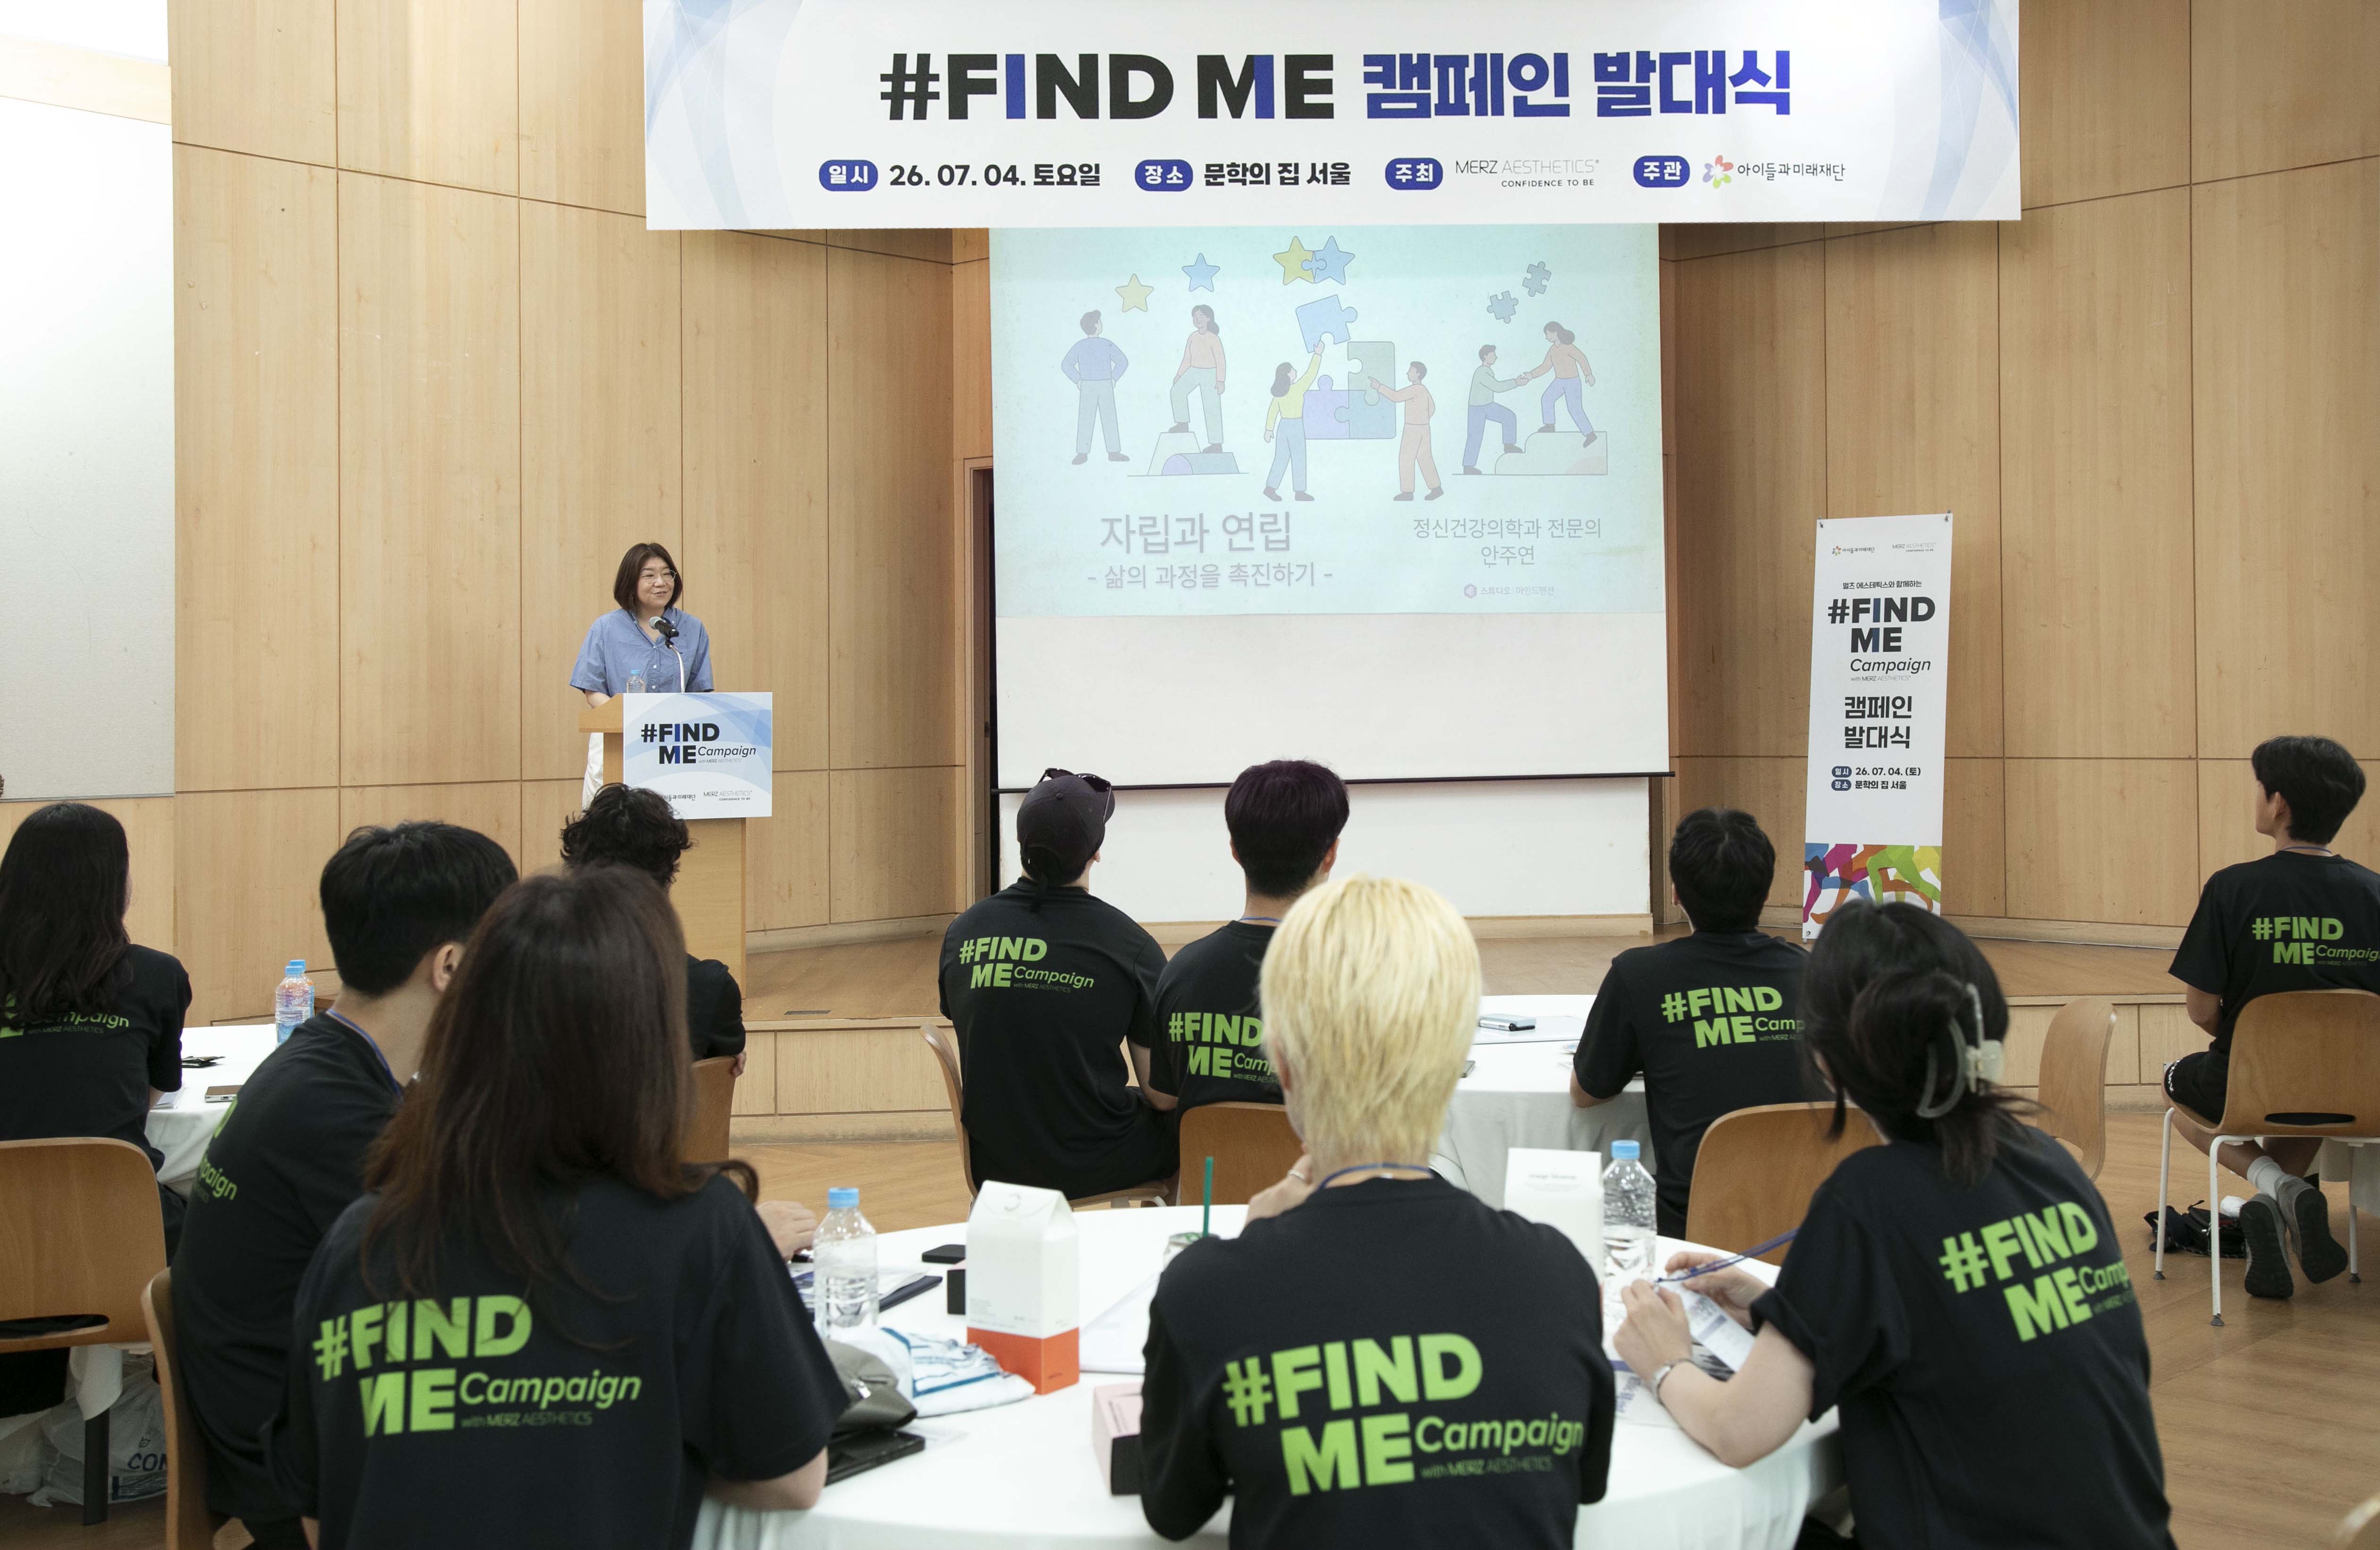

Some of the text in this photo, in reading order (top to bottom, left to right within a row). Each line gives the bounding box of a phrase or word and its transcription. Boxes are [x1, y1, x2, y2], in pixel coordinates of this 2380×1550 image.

[880, 51, 1790, 120] #FIND ME 캠페인 발대식
[829, 163, 1100, 186] 일시 26. 07. 04. 토요일
[1145, 162, 1351, 186] 장소 문학의 집 서울
[1396, 163, 1433, 182] 주최
[1456, 161, 1497, 173] MERZ
[1644, 162, 1681, 180] 주관
[1738, 163, 1845, 181] 아이들과미래재단
[1100, 511, 1290, 554] 자립과 연립
[1414, 518, 1600, 538] 정신건강의학과 전문의
[1481, 545, 1534, 566] 안주연
[1105, 565, 1146, 589] 삶의
[1156, 564, 1220, 589] 과정을
[1229, 562, 1314, 587] 촉진하기
[1856, 581, 1895, 589] 에스테틱스와
[1828, 597, 1935, 623] #FIND
[1851, 627, 1902, 653] ME
[1851, 658, 1930, 674] Campaign
[1845, 696, 1912, 718] 캠페인
[641, 723, 720, 742] #FIND
[1844, 726, 1910, 749] 발대식
[659, 745, 756, 764] ME Campaign
[1856, 767, 1870, 775] 26.
[1872, 767, 1886, 775] 07.
[1888, 767, 1903, 775] 04.
[1905, 767, 1921, 776] (토)
[1855, 780, 1878, 789] 문학의
[1881, 781, 1888, 789] 집
[1891, 781, 1906, 789] 서울
[2252, 917, 2344, 940] #FIND
[960, 937, 1047, 964] #FIND
[2273, 942, 2380, 964] ME Campaig
[970, 963, 1094, 989] ME Campaign
[1661, 987, 1783, 1023] #FIND
[1169, 1012, 1264, 1047] #FIND
[1694, 1016, 1756, 1048] ME
[1188, 1045, 1233, 1078] ME
[1939, 1201, 2098, 1293] #FIND
[2003, 1267, 2093, 1342] ME
[312, 1295, 533, 1382] #FIND
[1222, 1333, 1483, 1427] #FIND
[359, 1368, 642, 1438] ME Campaign
[1281, 1412, 1583, 1495] ME Campaign
